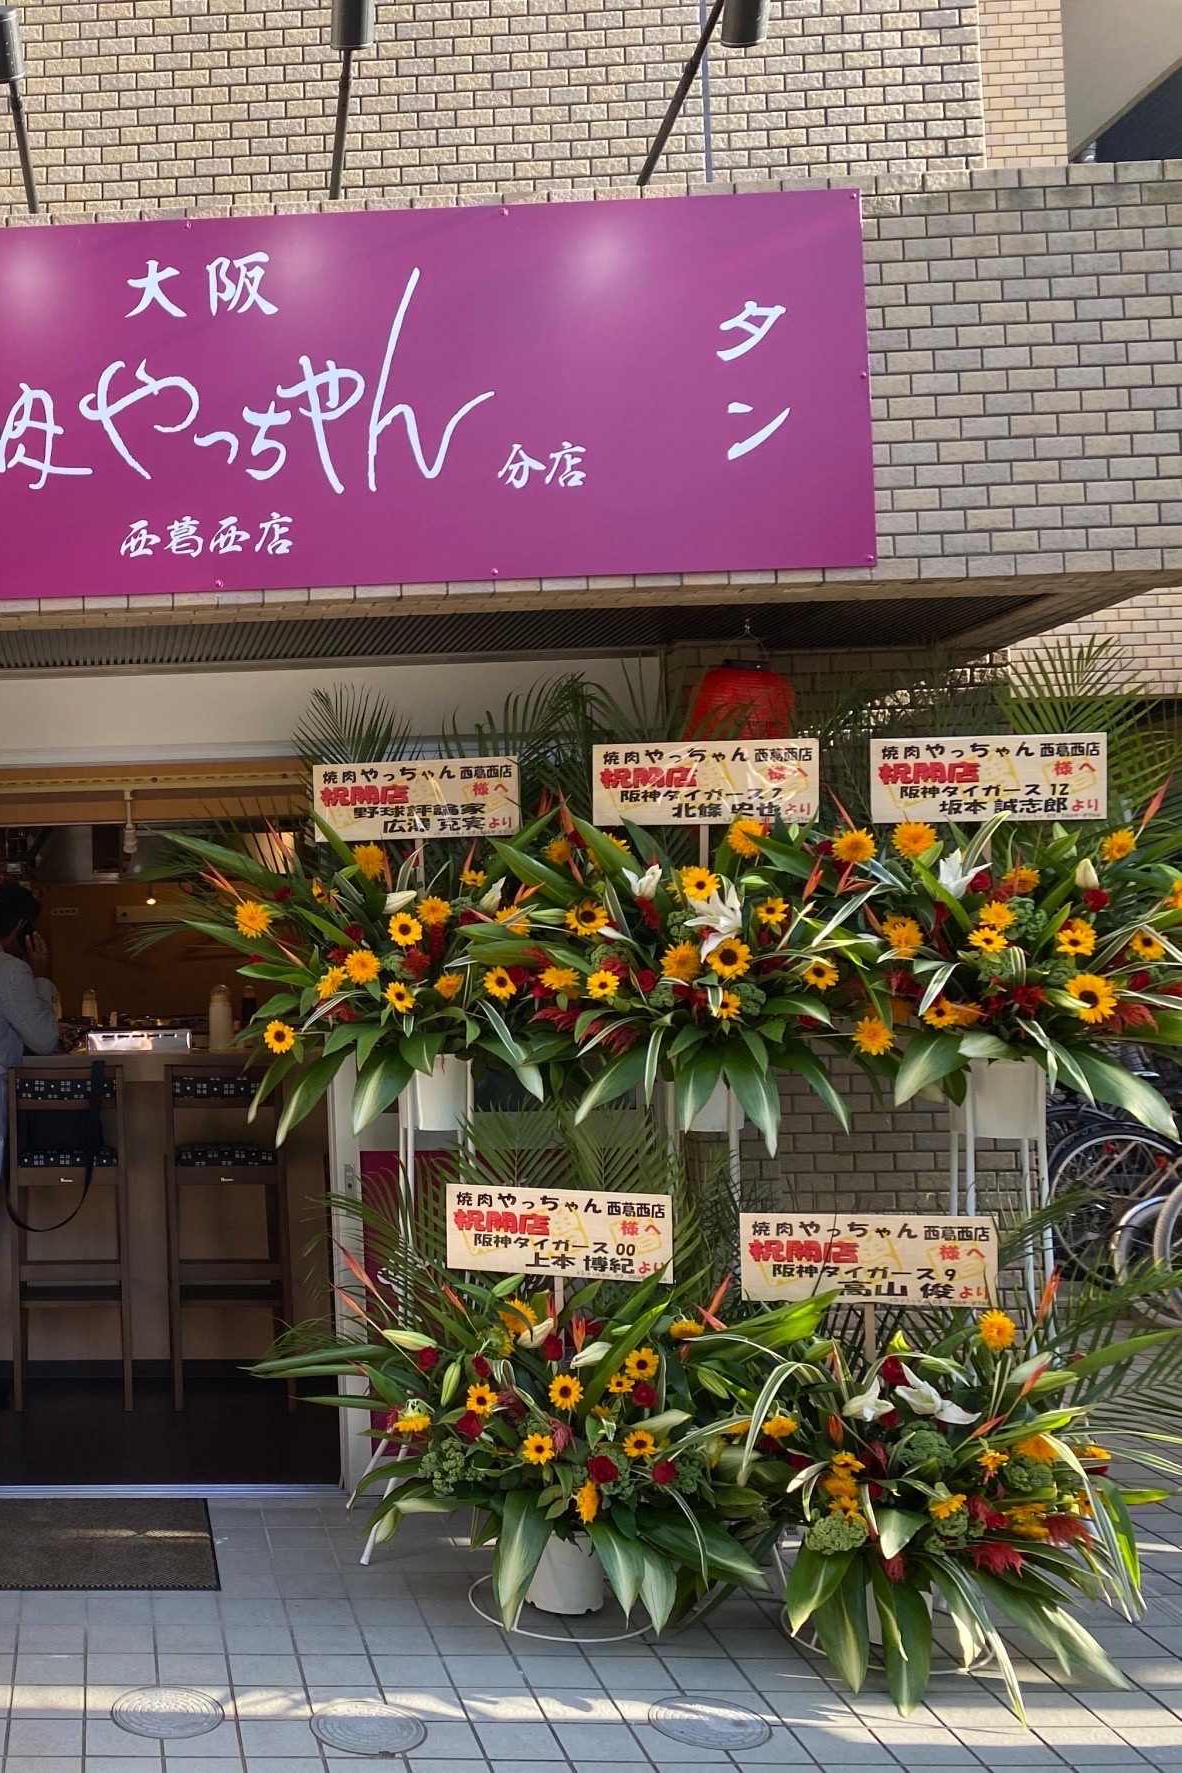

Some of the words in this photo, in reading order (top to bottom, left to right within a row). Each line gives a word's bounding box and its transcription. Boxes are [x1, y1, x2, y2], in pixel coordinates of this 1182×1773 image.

[125, 251, 279, 318] 大阪
[717, 300, 791, 460] タン
[498, 441, 587, 488] 分店
[120, 514, 294, 559] 西葛西店
[1040, 742, 1100, 758] 西葛西店
[460, 765, 513, 779] 西葛西店
[600, 767, 697, 789] 祝開店
[879, 761, 981, 785] 祝開店
[320, 785, 410, 807] 祝開店
[354, 803, 486, 818] 野球評論家
[607, 1201, 666, 1218] 西葛西店
[454, 1208, 551, 1236] 祝開店
[923, 1225, 990, 1242] 西葛西店
[748, 1239, 860, 1263] 祝開店
